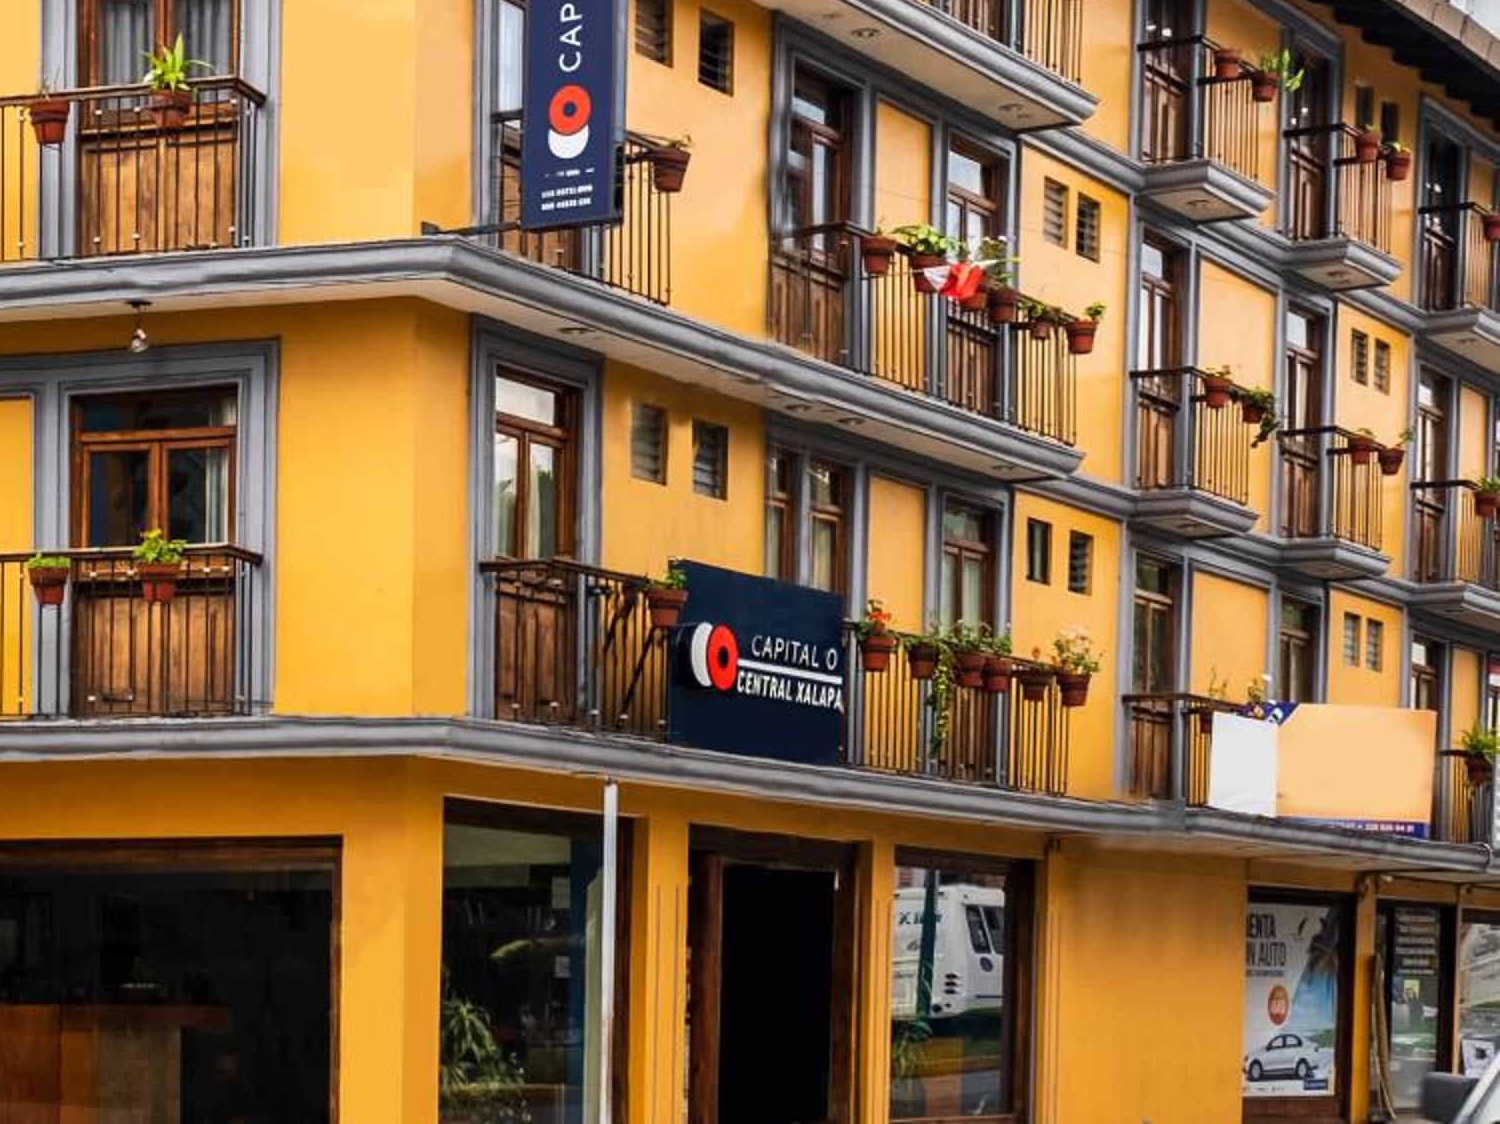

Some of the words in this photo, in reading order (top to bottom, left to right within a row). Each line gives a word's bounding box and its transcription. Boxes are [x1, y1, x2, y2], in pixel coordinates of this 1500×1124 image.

[751, 634, 820, 669] CAPITAL
[826, 648, 838, 671] O
[736, 670, 794, 702] CENTRAL
[795, 680, 845, 714] XALAPA
[1257, 942, 1287, 968] AUTO
